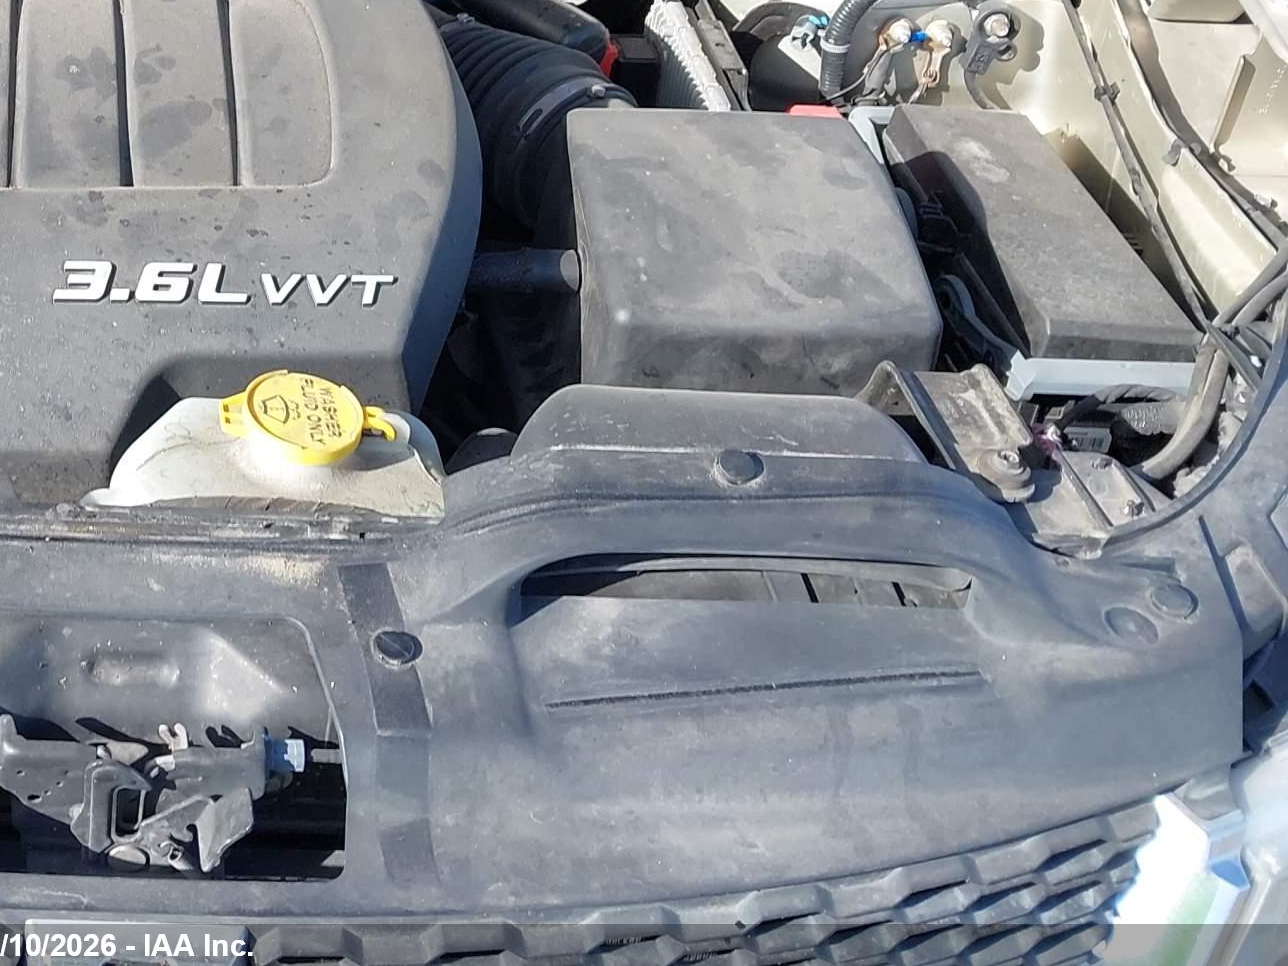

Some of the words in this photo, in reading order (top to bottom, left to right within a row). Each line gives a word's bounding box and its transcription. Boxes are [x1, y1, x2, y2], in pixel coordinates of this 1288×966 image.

[52, 260, 252, 306] 3.6L
[261, 273, 399, 307] VVT
[306, 414, 327, 446] ONLY
